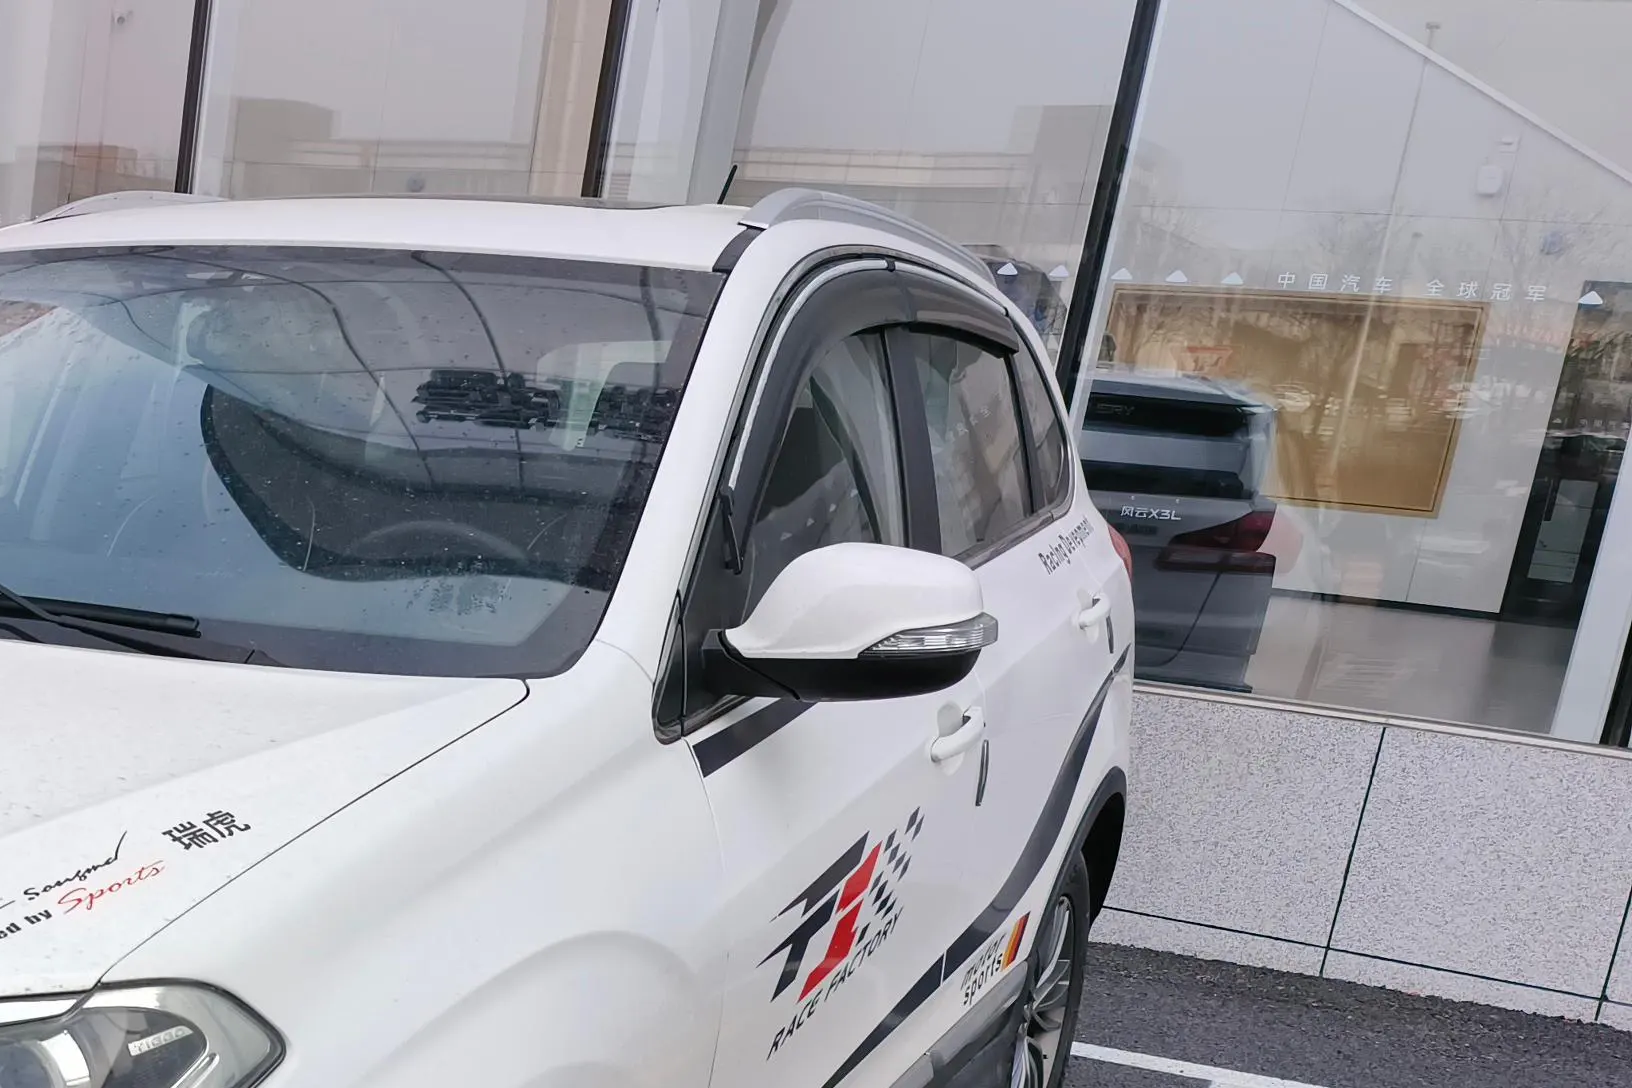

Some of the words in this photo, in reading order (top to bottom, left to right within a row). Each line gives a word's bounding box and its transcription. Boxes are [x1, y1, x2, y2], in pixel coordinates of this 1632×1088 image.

[1277, 271, 1393, 294] 中国汽车
[1425, 279, 1547, 302] 全球冠军
[1120, 505, 1182, 521] 风云X3L
[1038, 544, 1070, 575] Racing
[162, 810, 251, 851] 瑞虎
[24, 909, 53, 926] by
[57, 860, 166, 914] Sports
[766, 988, 824, 1062] RACE
[824, 905, 904, 1002] FACTORY
